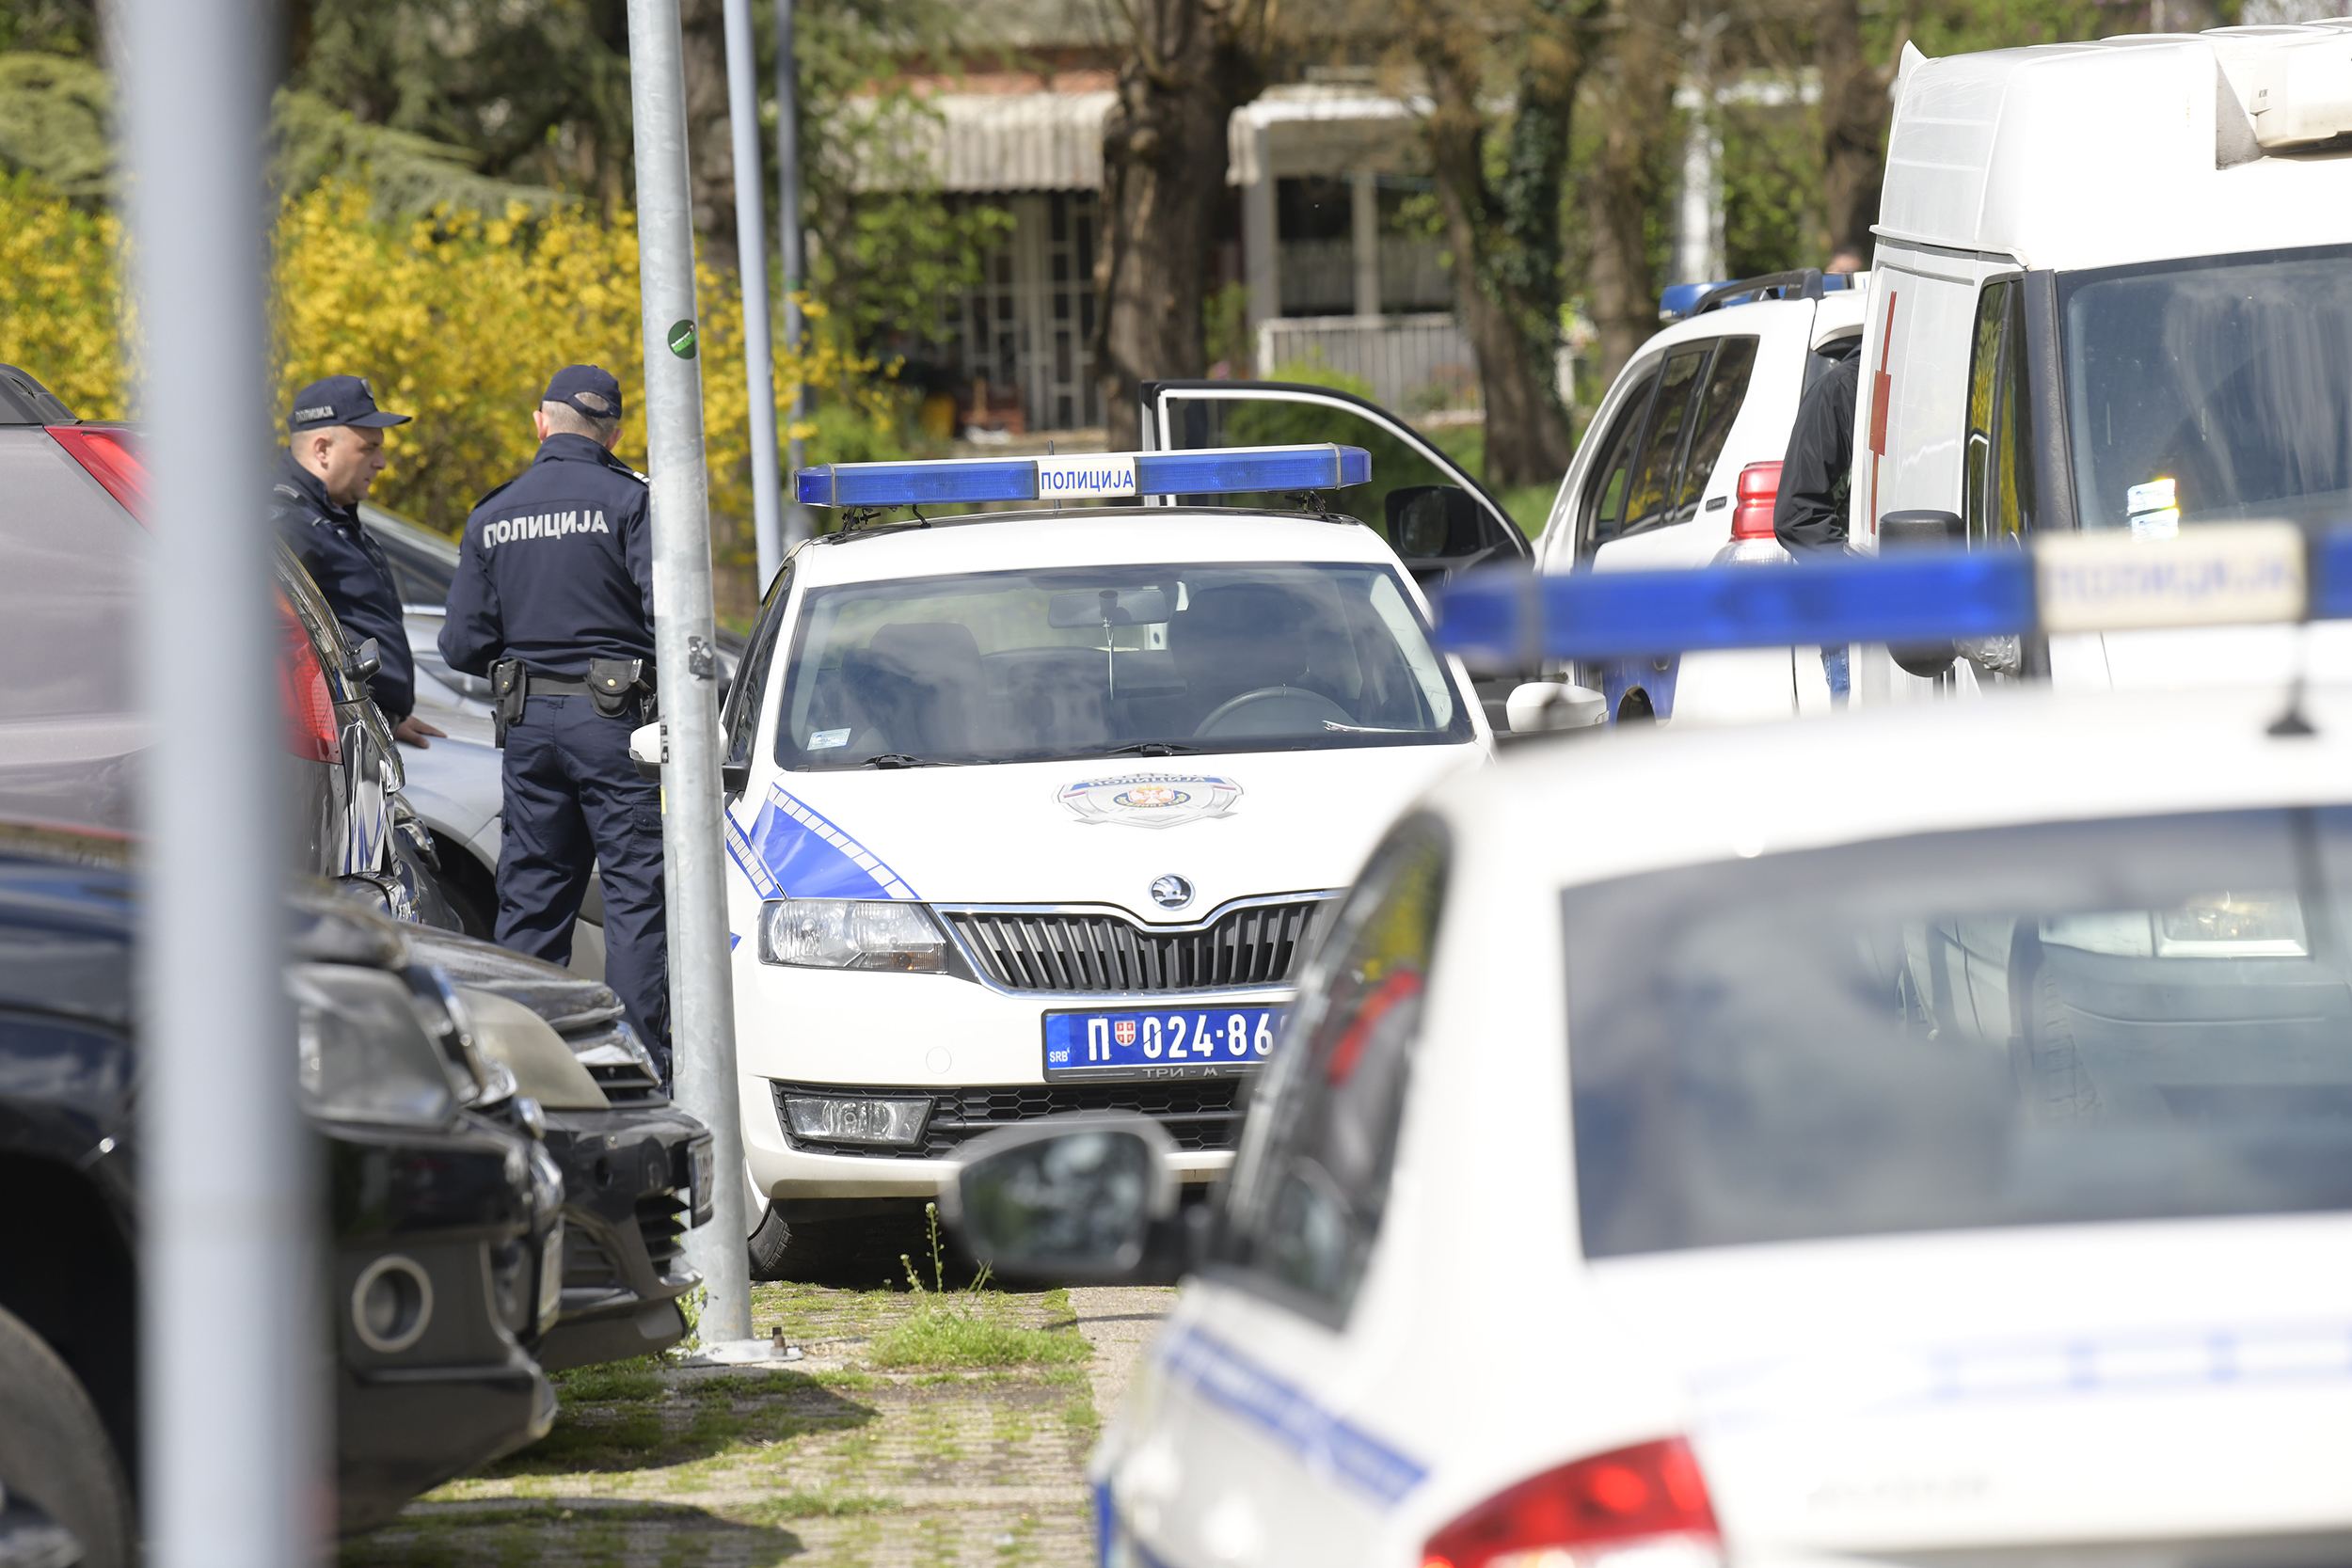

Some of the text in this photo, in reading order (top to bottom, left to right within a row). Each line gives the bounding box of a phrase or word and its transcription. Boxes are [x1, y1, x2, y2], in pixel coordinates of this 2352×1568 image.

[1041, 469, 1135, 493] ПОЛИЦИЈА
[483, 509, 610, 549] ПОЛИЦИЈА
[1087, 776, 1207, 787] ПОЛИЦИЈА
[1087, 1018, 1111, 1061] П
[1049, 1051, 1069, 1063] SRB
[1142, 1068, 1184, 1079] ТРИ
